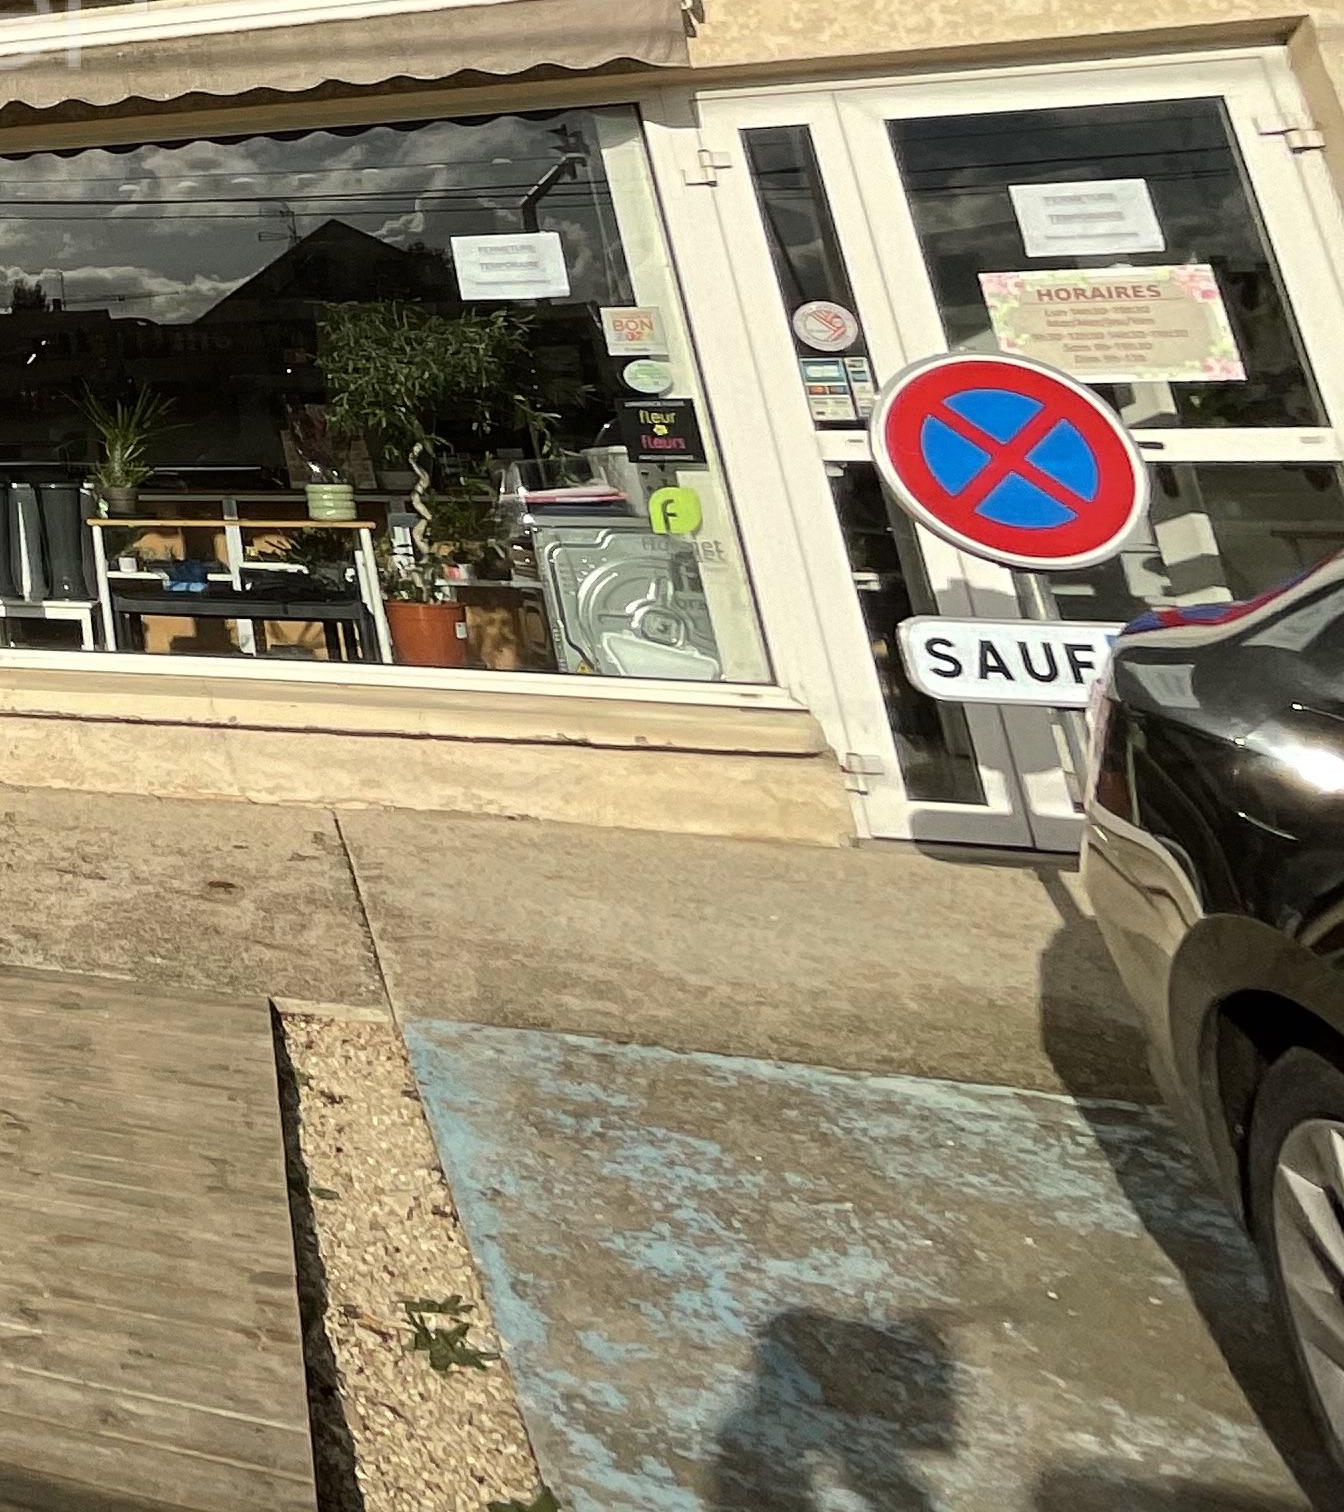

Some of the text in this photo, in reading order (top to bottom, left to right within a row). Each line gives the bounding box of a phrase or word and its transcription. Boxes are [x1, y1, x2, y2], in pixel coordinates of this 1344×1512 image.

[1037, 285, 1162, 302] HORAIRES
[639, 409, 677, 424] fleur
[641, 435, 686, 450] fleurs
[924, 638, 1096, 684] SAUF
